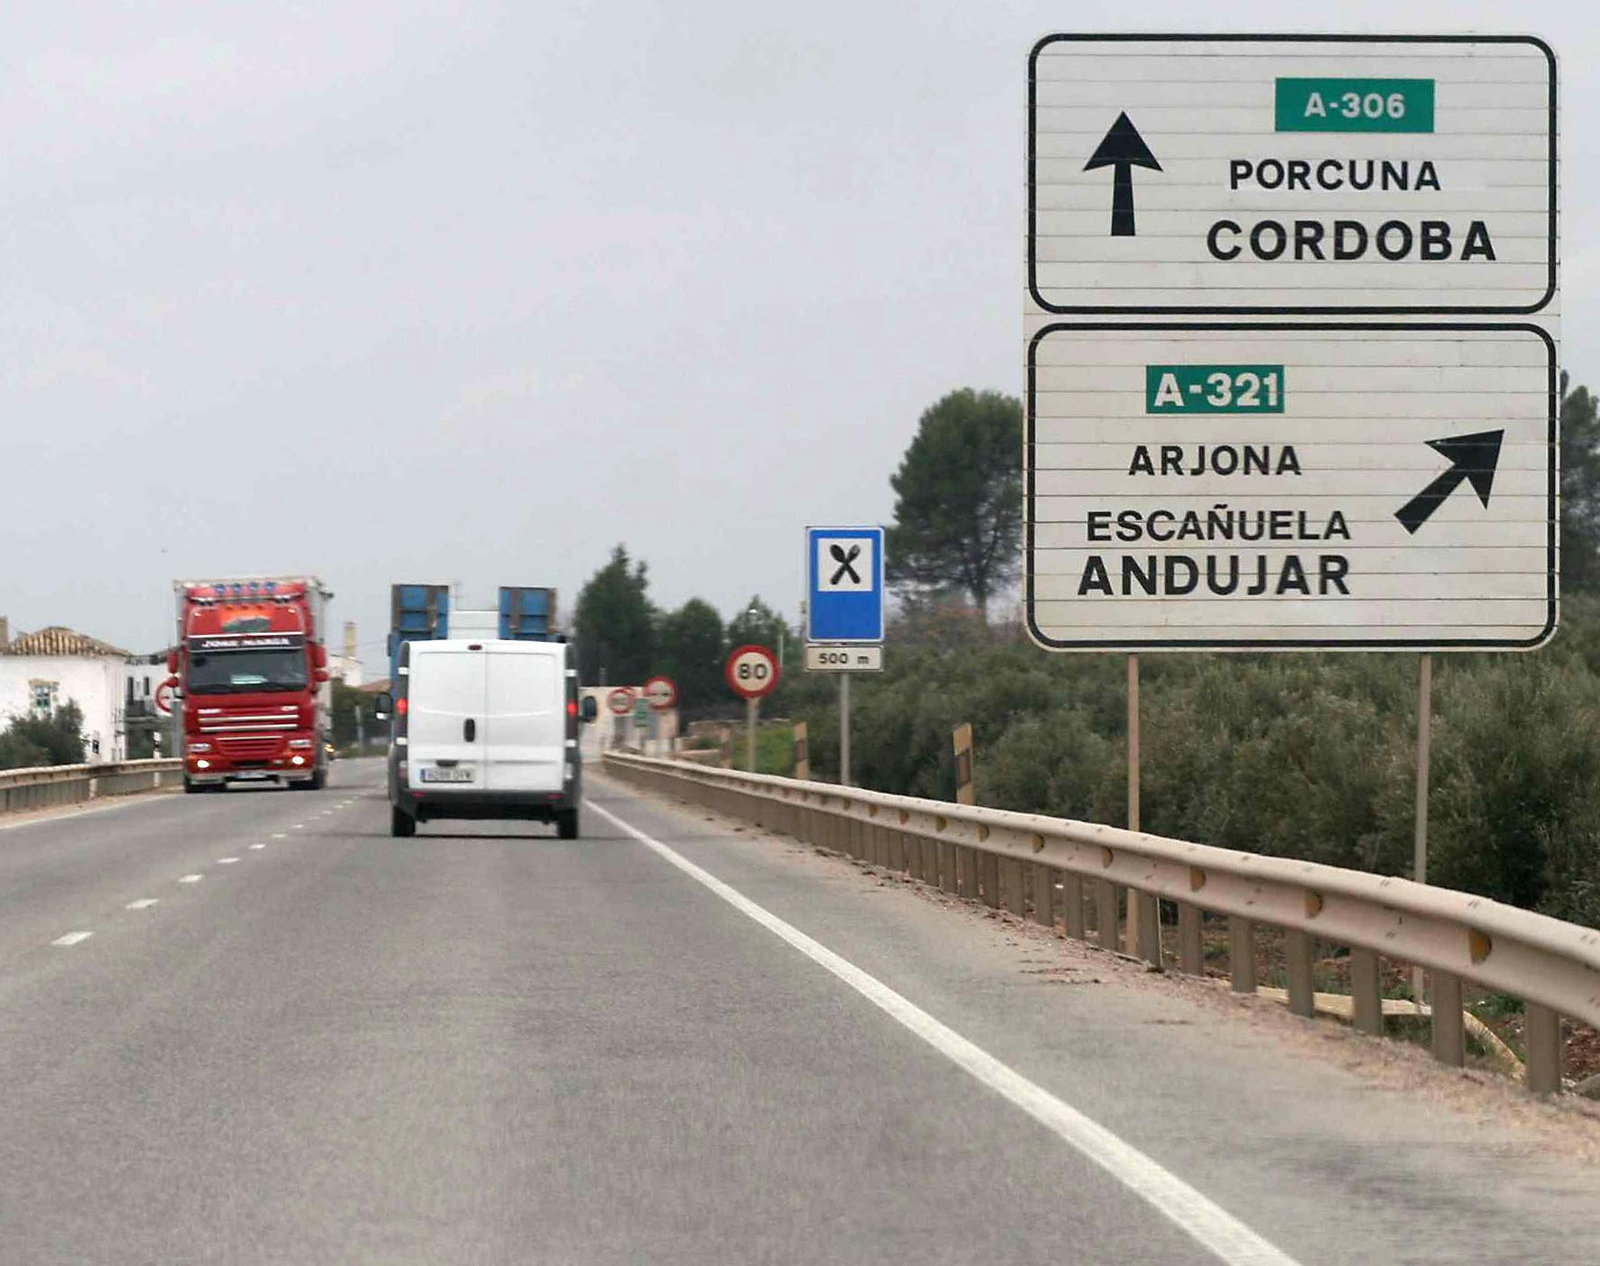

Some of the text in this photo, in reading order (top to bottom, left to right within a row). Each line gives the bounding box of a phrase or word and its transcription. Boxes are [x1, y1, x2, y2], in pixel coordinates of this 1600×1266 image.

[1305, 93, 1405, 118] A-306
[1230, 159, 1441, 191] PORCUNA
[1206, 219, 1497, 261] CORDOBA
[1154, 372, 1278, 407] A-321
[1129, 445, 1302, 476] ARJONA
[1087, 503, 1351, 541] ESCAÑUELA
[1078, 555, 1351, 596] ANDUJAR
[739, 663, 768, 680] 80
[819, 653, 869, 664] 500 m
